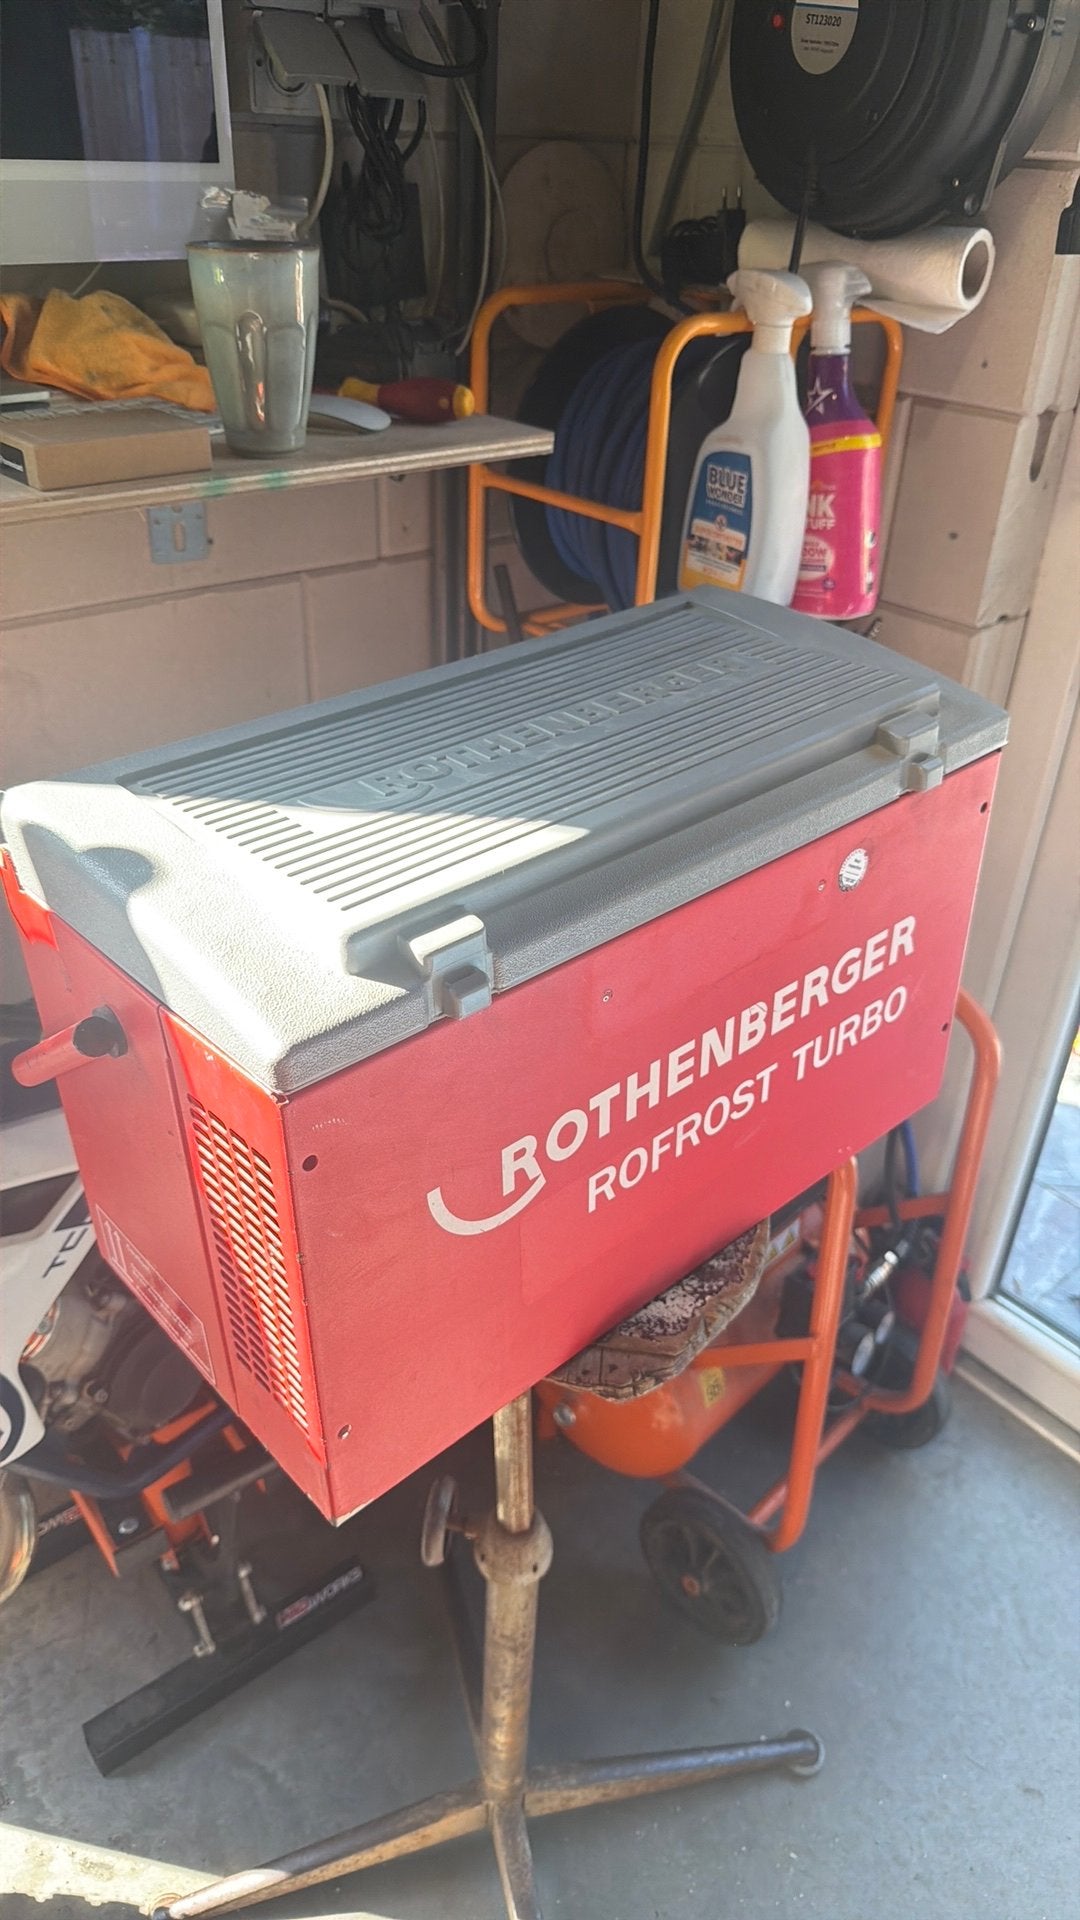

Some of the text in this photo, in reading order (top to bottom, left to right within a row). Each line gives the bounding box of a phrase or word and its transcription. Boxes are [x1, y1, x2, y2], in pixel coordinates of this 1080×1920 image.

[805, 13, 842, 27] ST123020
[708, 466, 746, 494] BLUE
[356, 650, 747, 797] ROTHENBERGER
[501, 914, 917, 1197] ROTHENBERGER
[587, 984, 908, 1213] ROFROST TURBO
